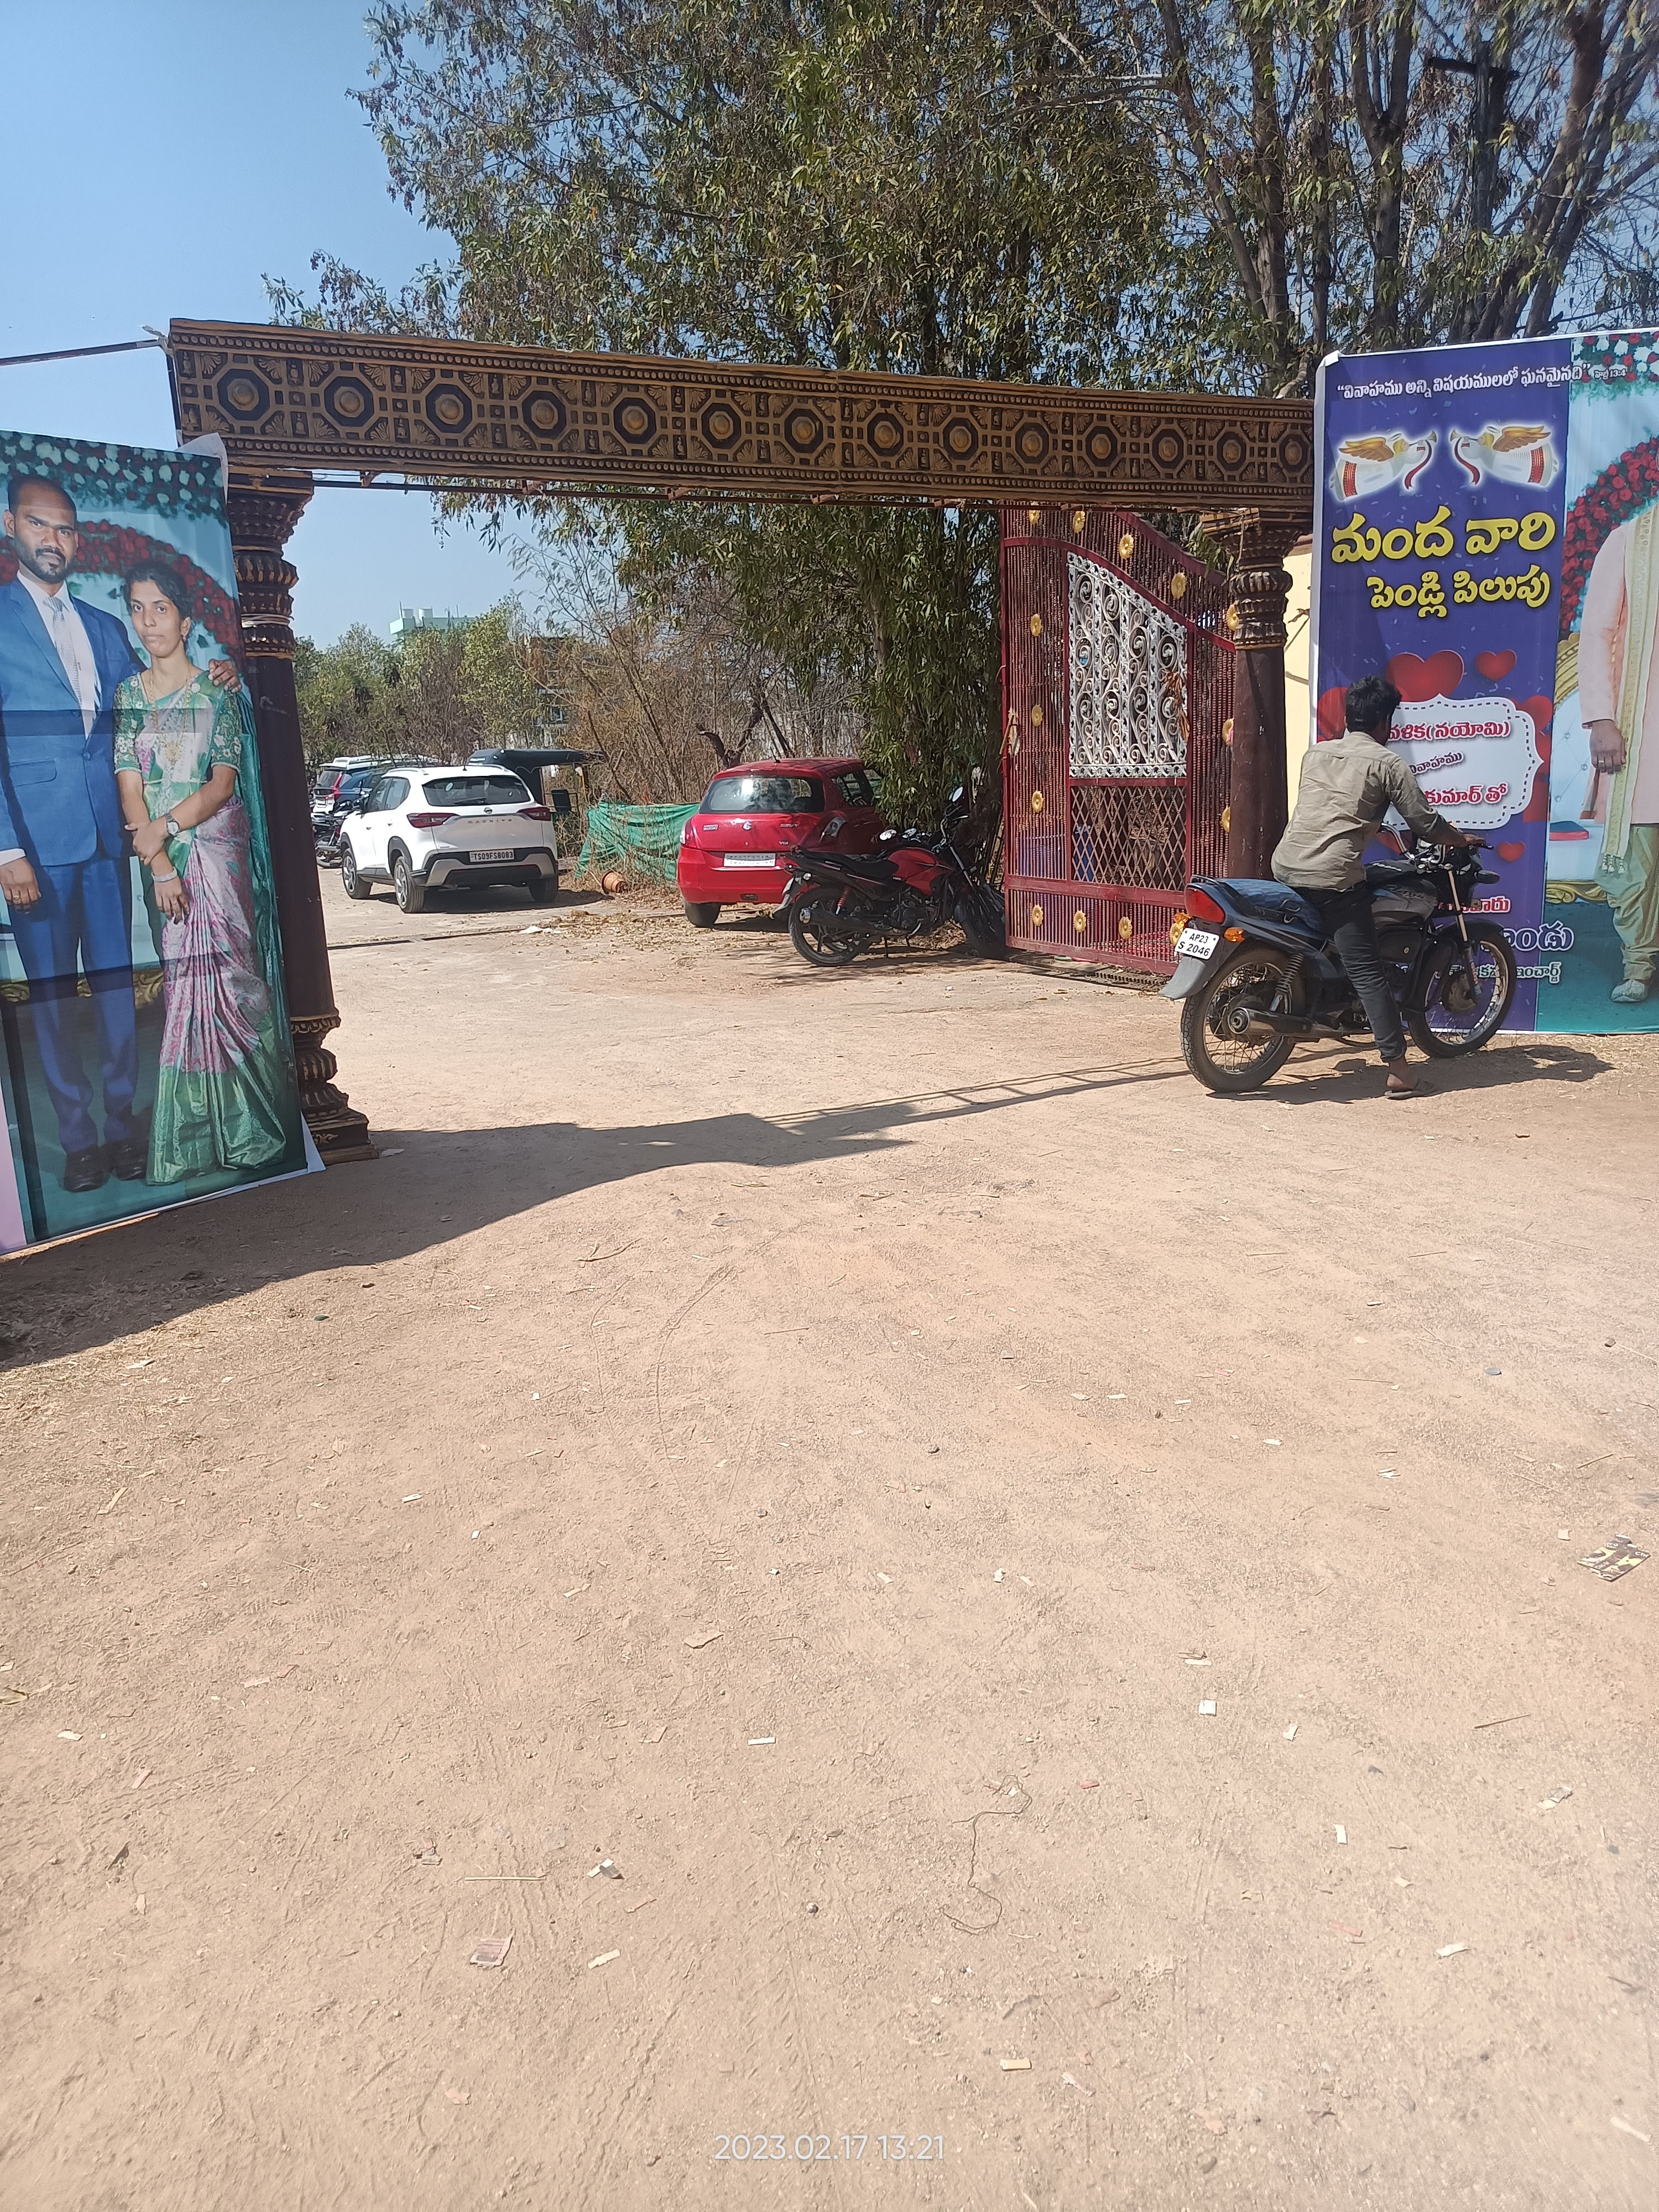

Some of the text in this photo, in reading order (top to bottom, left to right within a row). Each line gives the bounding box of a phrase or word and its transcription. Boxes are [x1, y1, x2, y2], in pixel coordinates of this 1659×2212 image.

[1405, 379, 1432, 398] అన్ని
[1433, 366, 1519, 393] విషయములలో
[1331, 505, 1556, 563] మంద వారి
[1366, 564, 1550, 618] పెండ్లి పిలుపు
[1485, 782, 1506, 802] తో
[473, 851, 513, 860] TS09FS8083
[1189, 933, 1209, 944] AP23
[1178, 941, 1211, 957] S 2046
